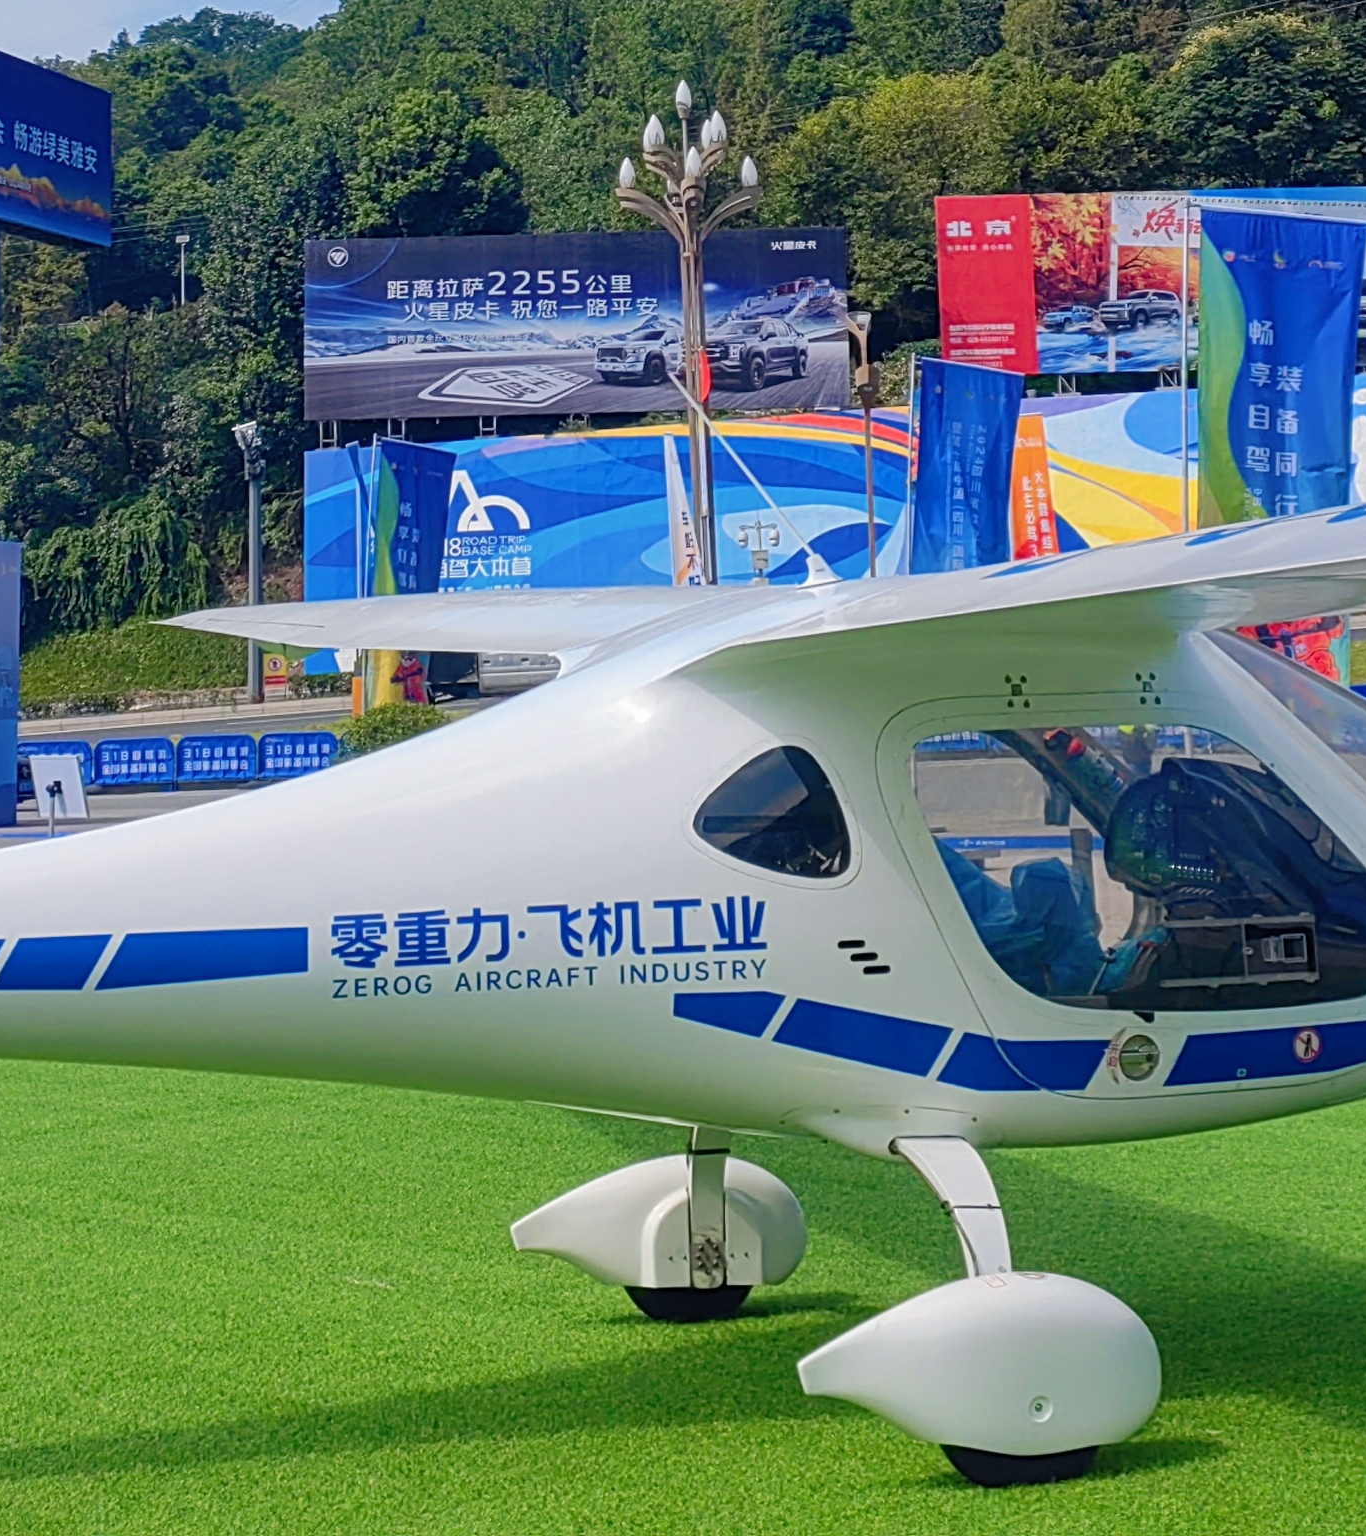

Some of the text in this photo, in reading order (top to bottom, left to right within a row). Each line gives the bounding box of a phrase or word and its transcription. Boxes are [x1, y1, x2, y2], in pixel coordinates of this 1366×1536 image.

[13, 119, 98, 175] 畅游绿美雅安
[770, 240, 817, 251] 火星皮卡
[386, 268, 633, 300] 距离拉萨2255公里
[403, 296, 660, 322] 火星皮卡 祝您一路平安
[1245, 319, 1274, 473] 畅享自驾
[444, 535, 526, 557] 18 ROAD TRIP
[462, 544, 532, 556] BASE CAMP
[330, 895, 768, 969] 零重力·飞机工业
[331, 958, 768, 999] ZEROG AIRCRAFT INDUSTRY
